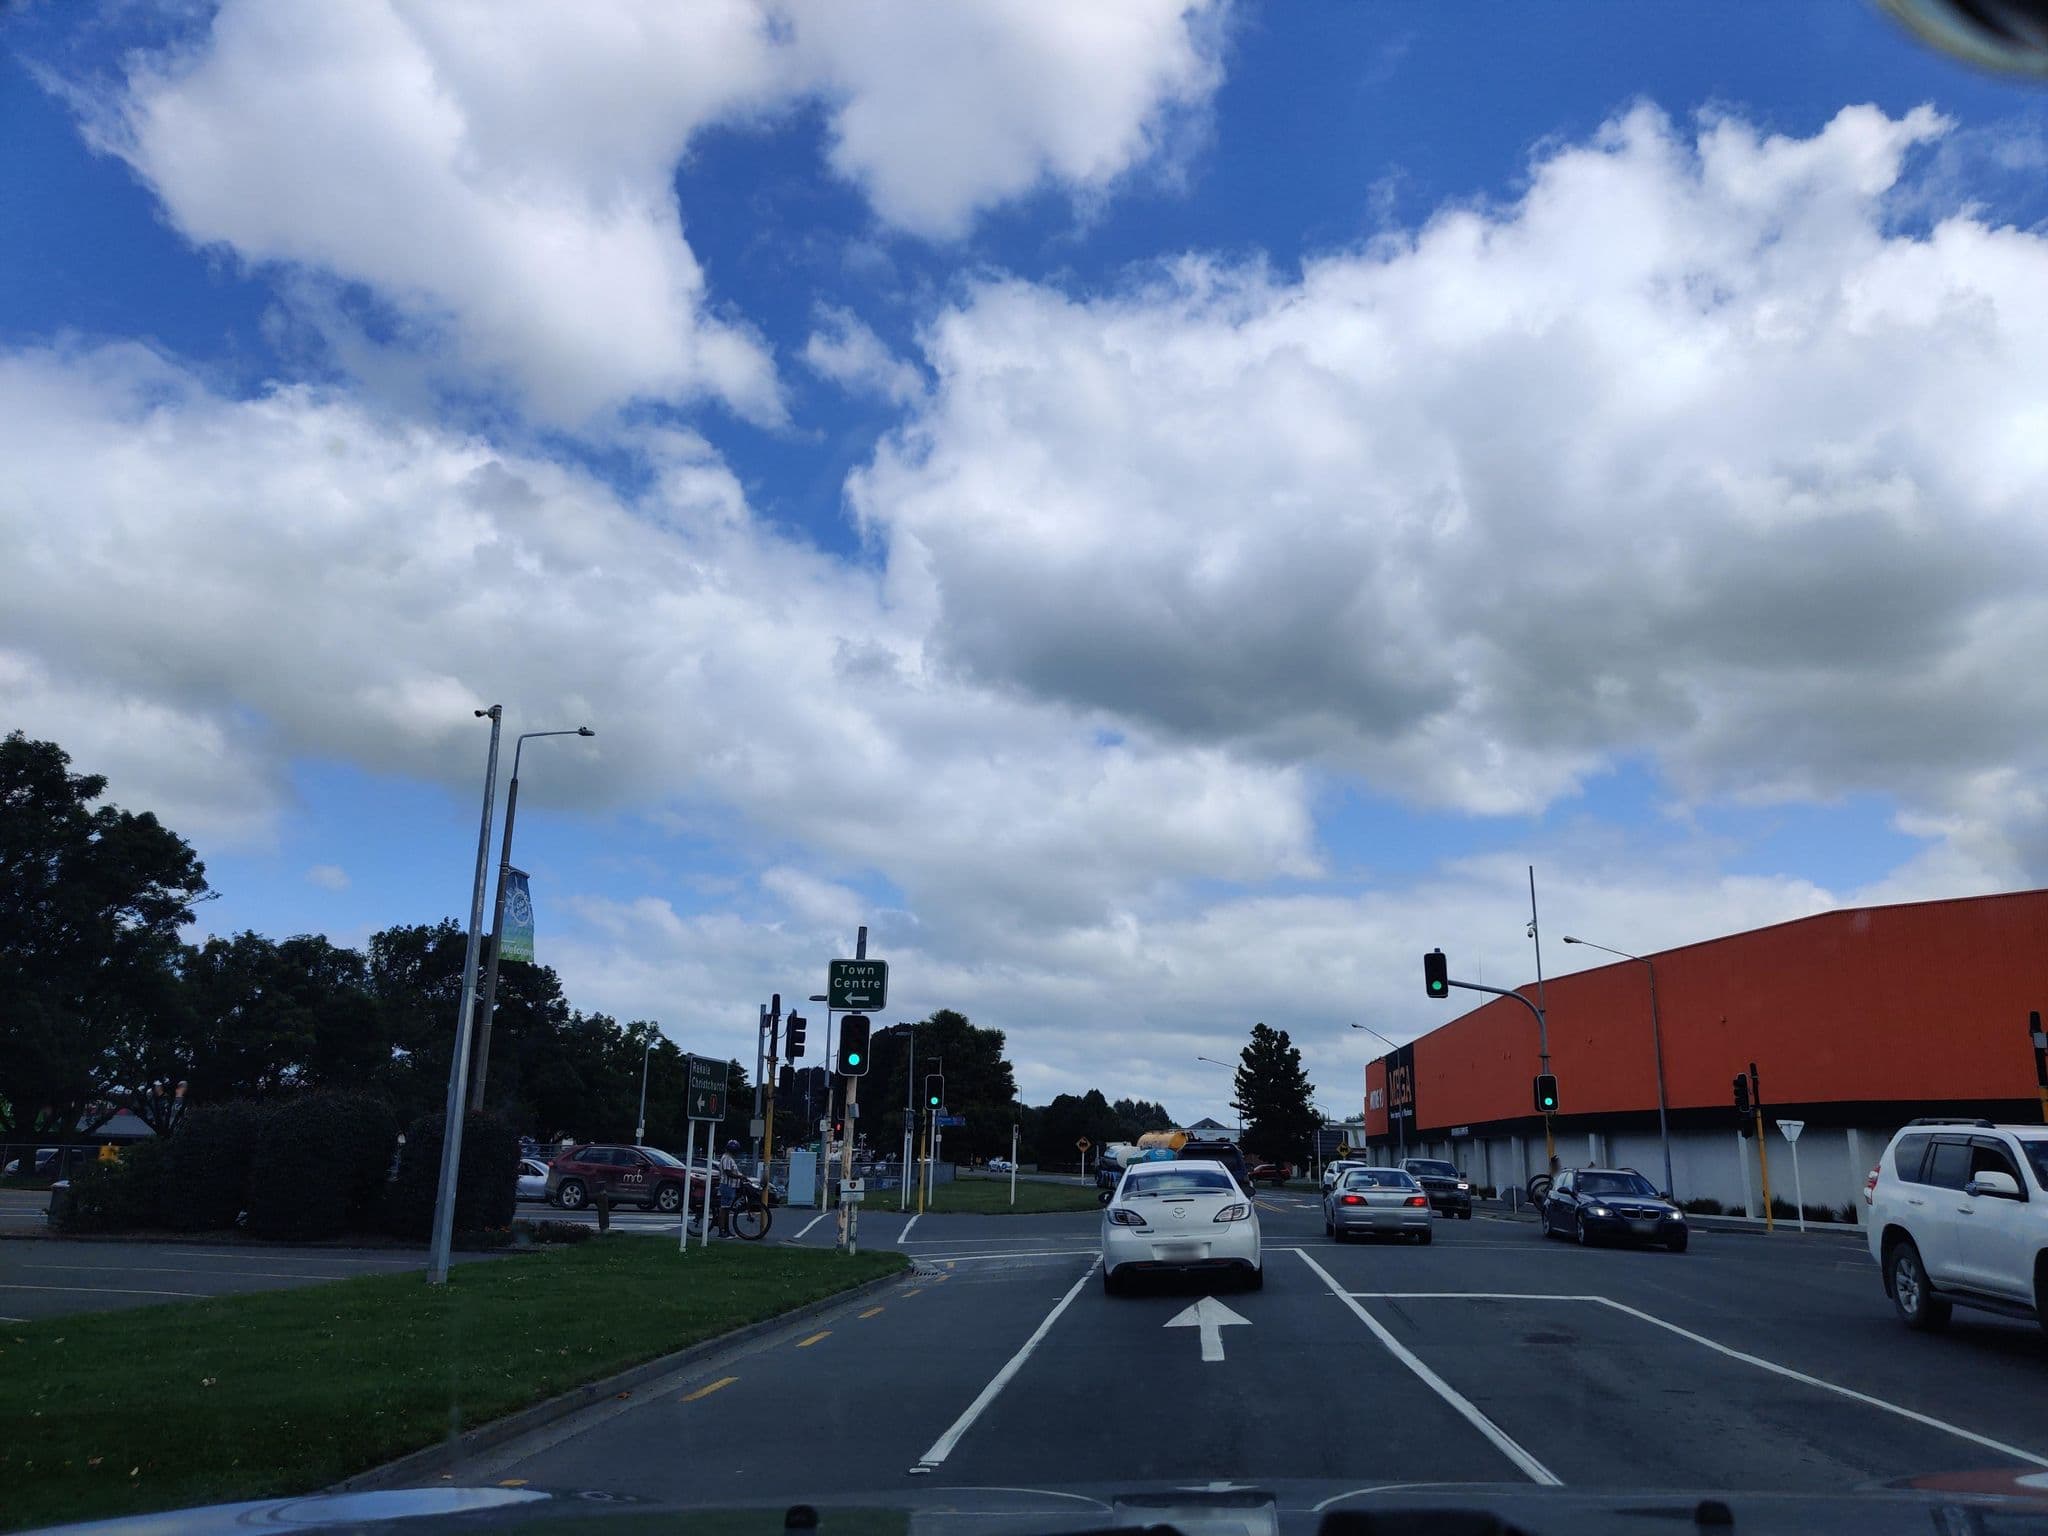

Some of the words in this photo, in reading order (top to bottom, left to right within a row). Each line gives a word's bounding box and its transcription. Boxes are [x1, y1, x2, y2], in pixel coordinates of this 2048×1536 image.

[840, 964, 874, 975] Town
[834, 977, 881, 989] Centre
[1388, 1065, 1412, 1106] MEGA
